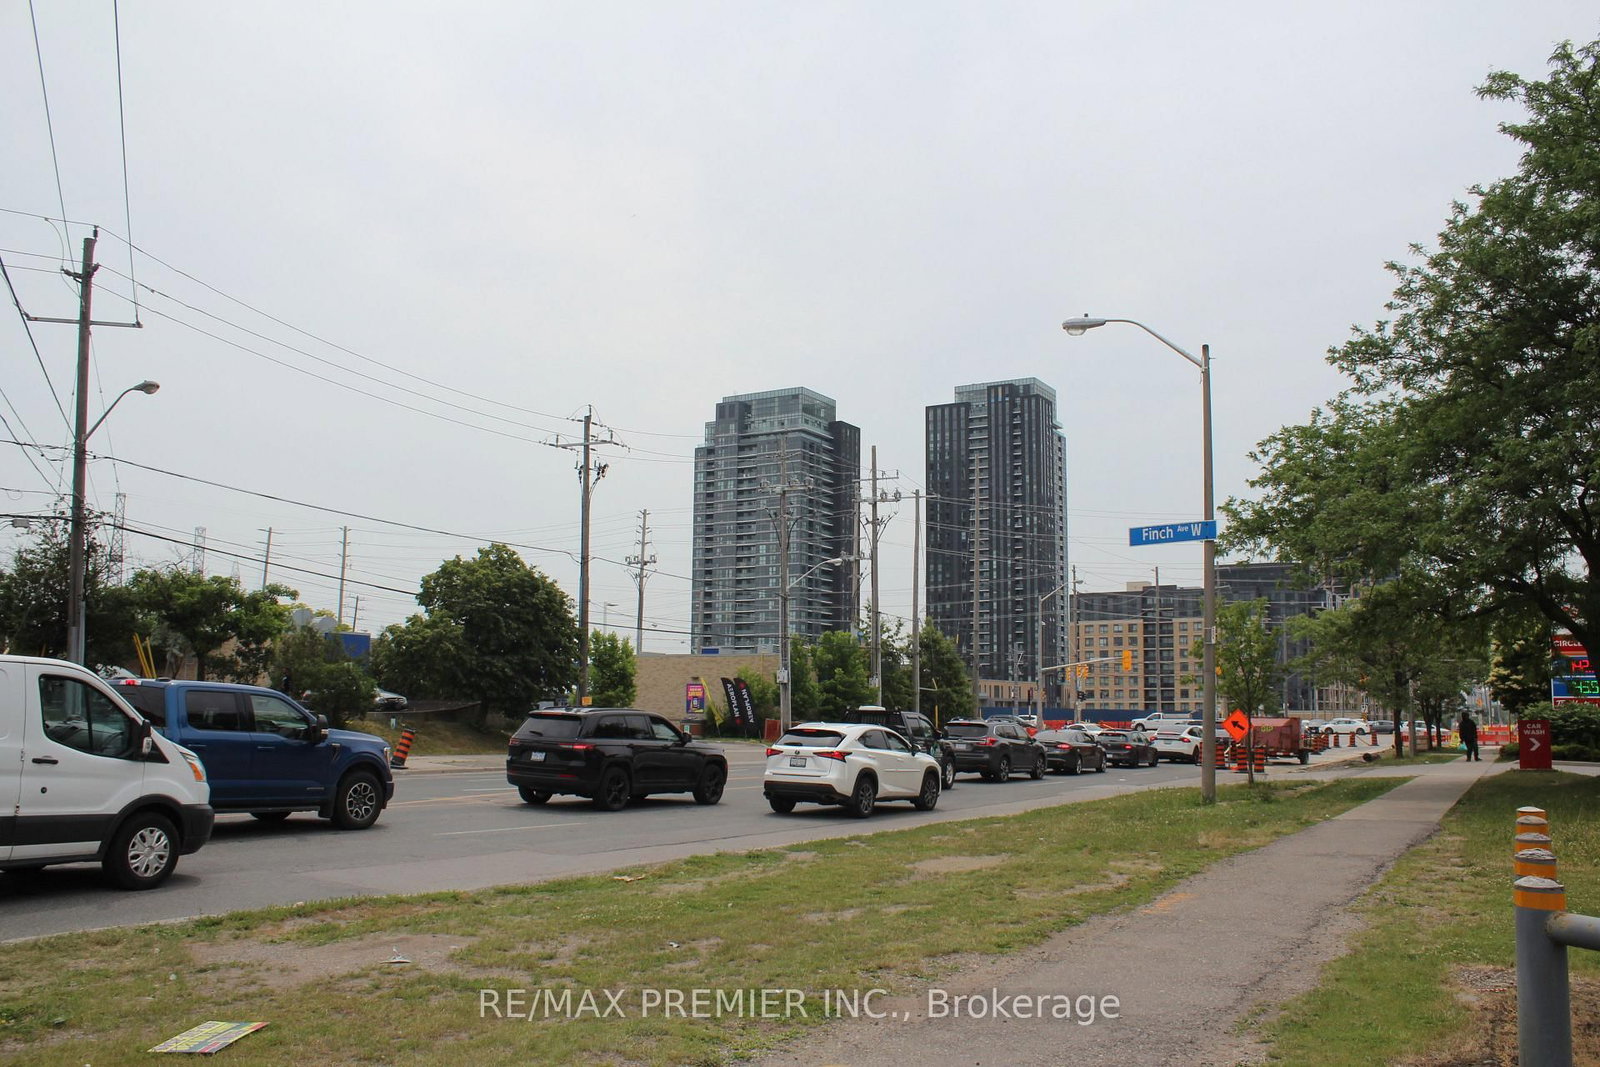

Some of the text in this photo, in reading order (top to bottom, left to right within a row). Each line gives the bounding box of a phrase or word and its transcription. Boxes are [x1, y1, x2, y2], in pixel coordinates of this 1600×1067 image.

[1142, 523, 1202, 541] Finch Ave W
[727, 683, 740, 717] AEROPLAN
[741, 689, 754, 723] AEROPLAN
